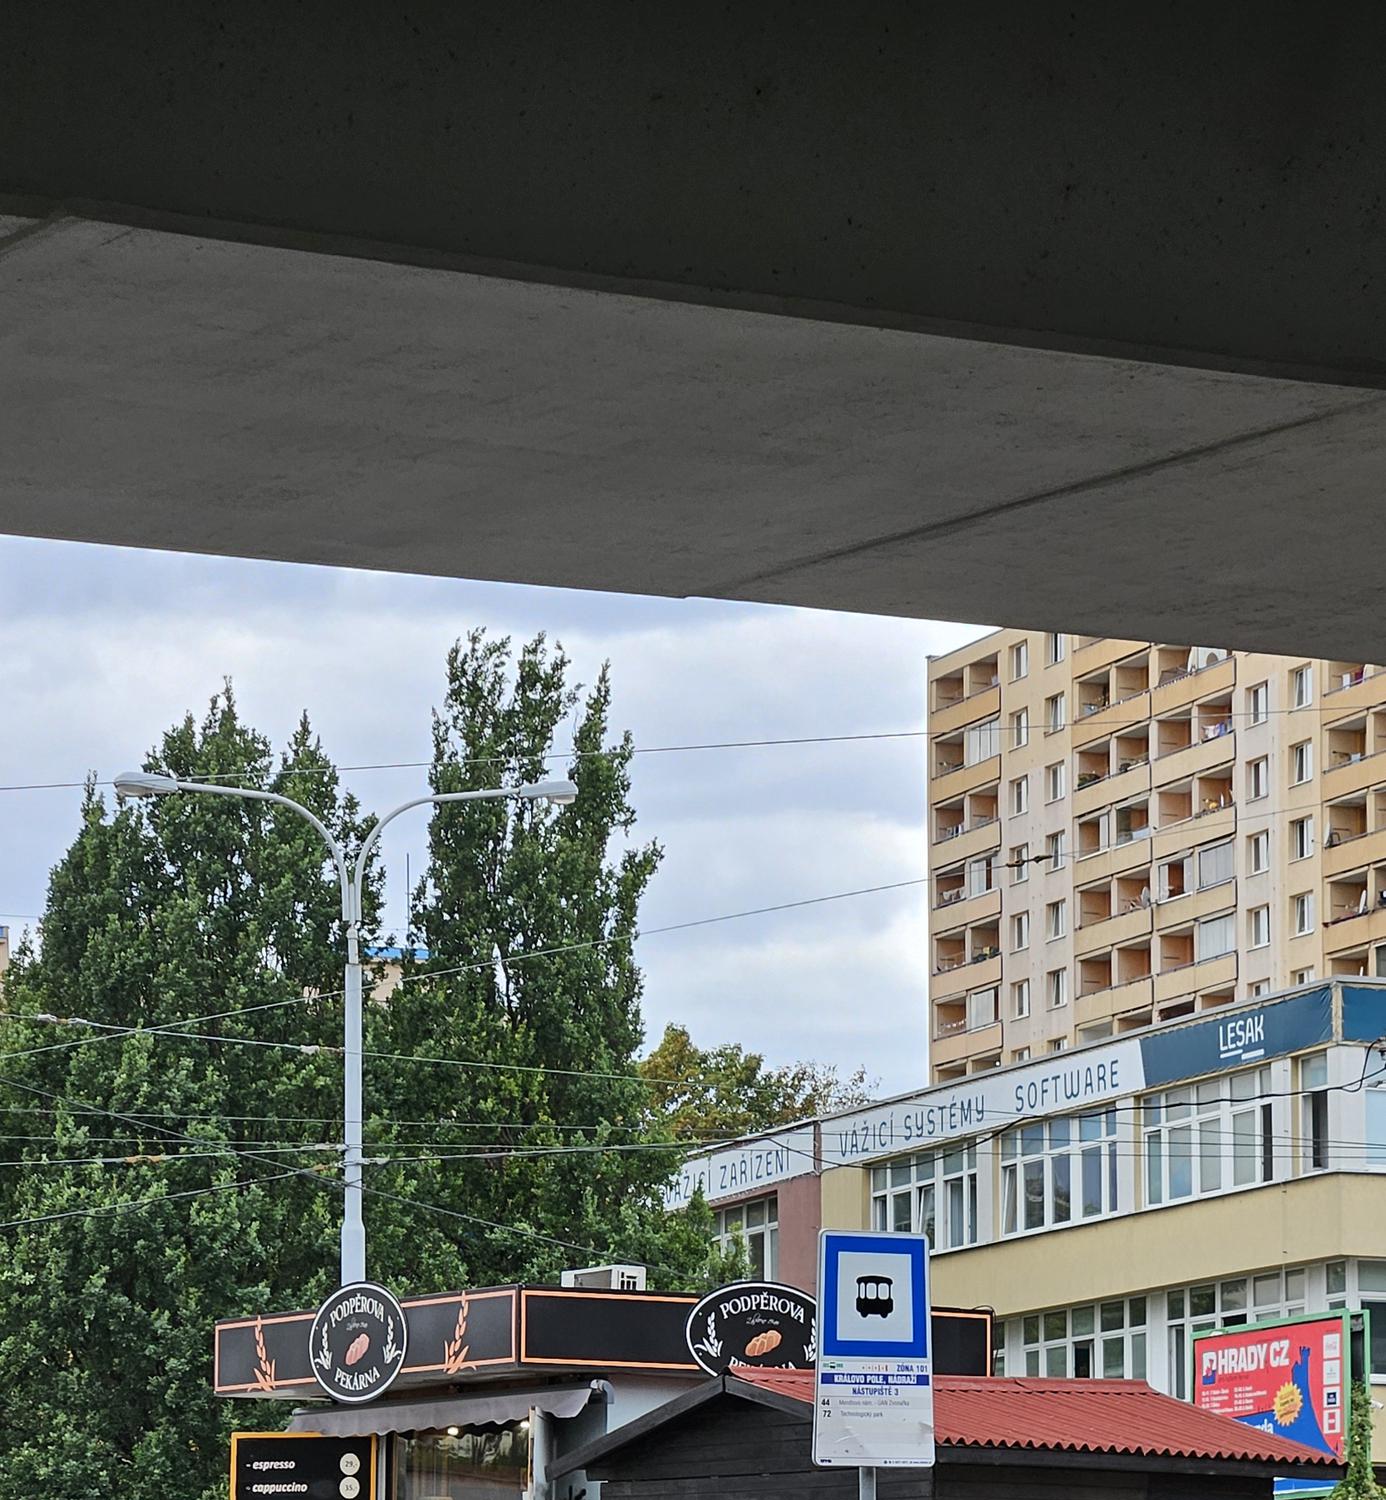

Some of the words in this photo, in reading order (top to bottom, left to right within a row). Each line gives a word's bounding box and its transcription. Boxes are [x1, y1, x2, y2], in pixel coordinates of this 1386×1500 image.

[1219, 1014, 1265, 1051] LESAK
[839, 1112, 894, 1158] VÁŽICÍ
[904, 1095, 985, 1142] SYSTÉMY
[1014, 1059, 1120, 1113] SOFTWARE
[720, 1139, 791, 1190] ZAŘÍZENÍ
[330, 1292, 385, 1328] PODPĚROVA
[719, 1291, 805, 1324] PODPĚROVA
[1217, 1343, 1268, 1375] HRADY
[1269, 1339, 1290, 1368] CZ
[896, 1362, 914, 1373] ZÓNA
[916, 1364, 928, 1373] 101
[334, 1366, 381, 1391] PEKÁRNA
[833, 1373, 865, 1384] KRÁLOVO
[893, 1388, 899, 1396] 3
[821, 1398, 830, 1406] 44
[822, 1409, 832, 1418] 72
[252, 1460, 295, 1471] espresso
[252, 1482, 308, 1494] cappuccino
